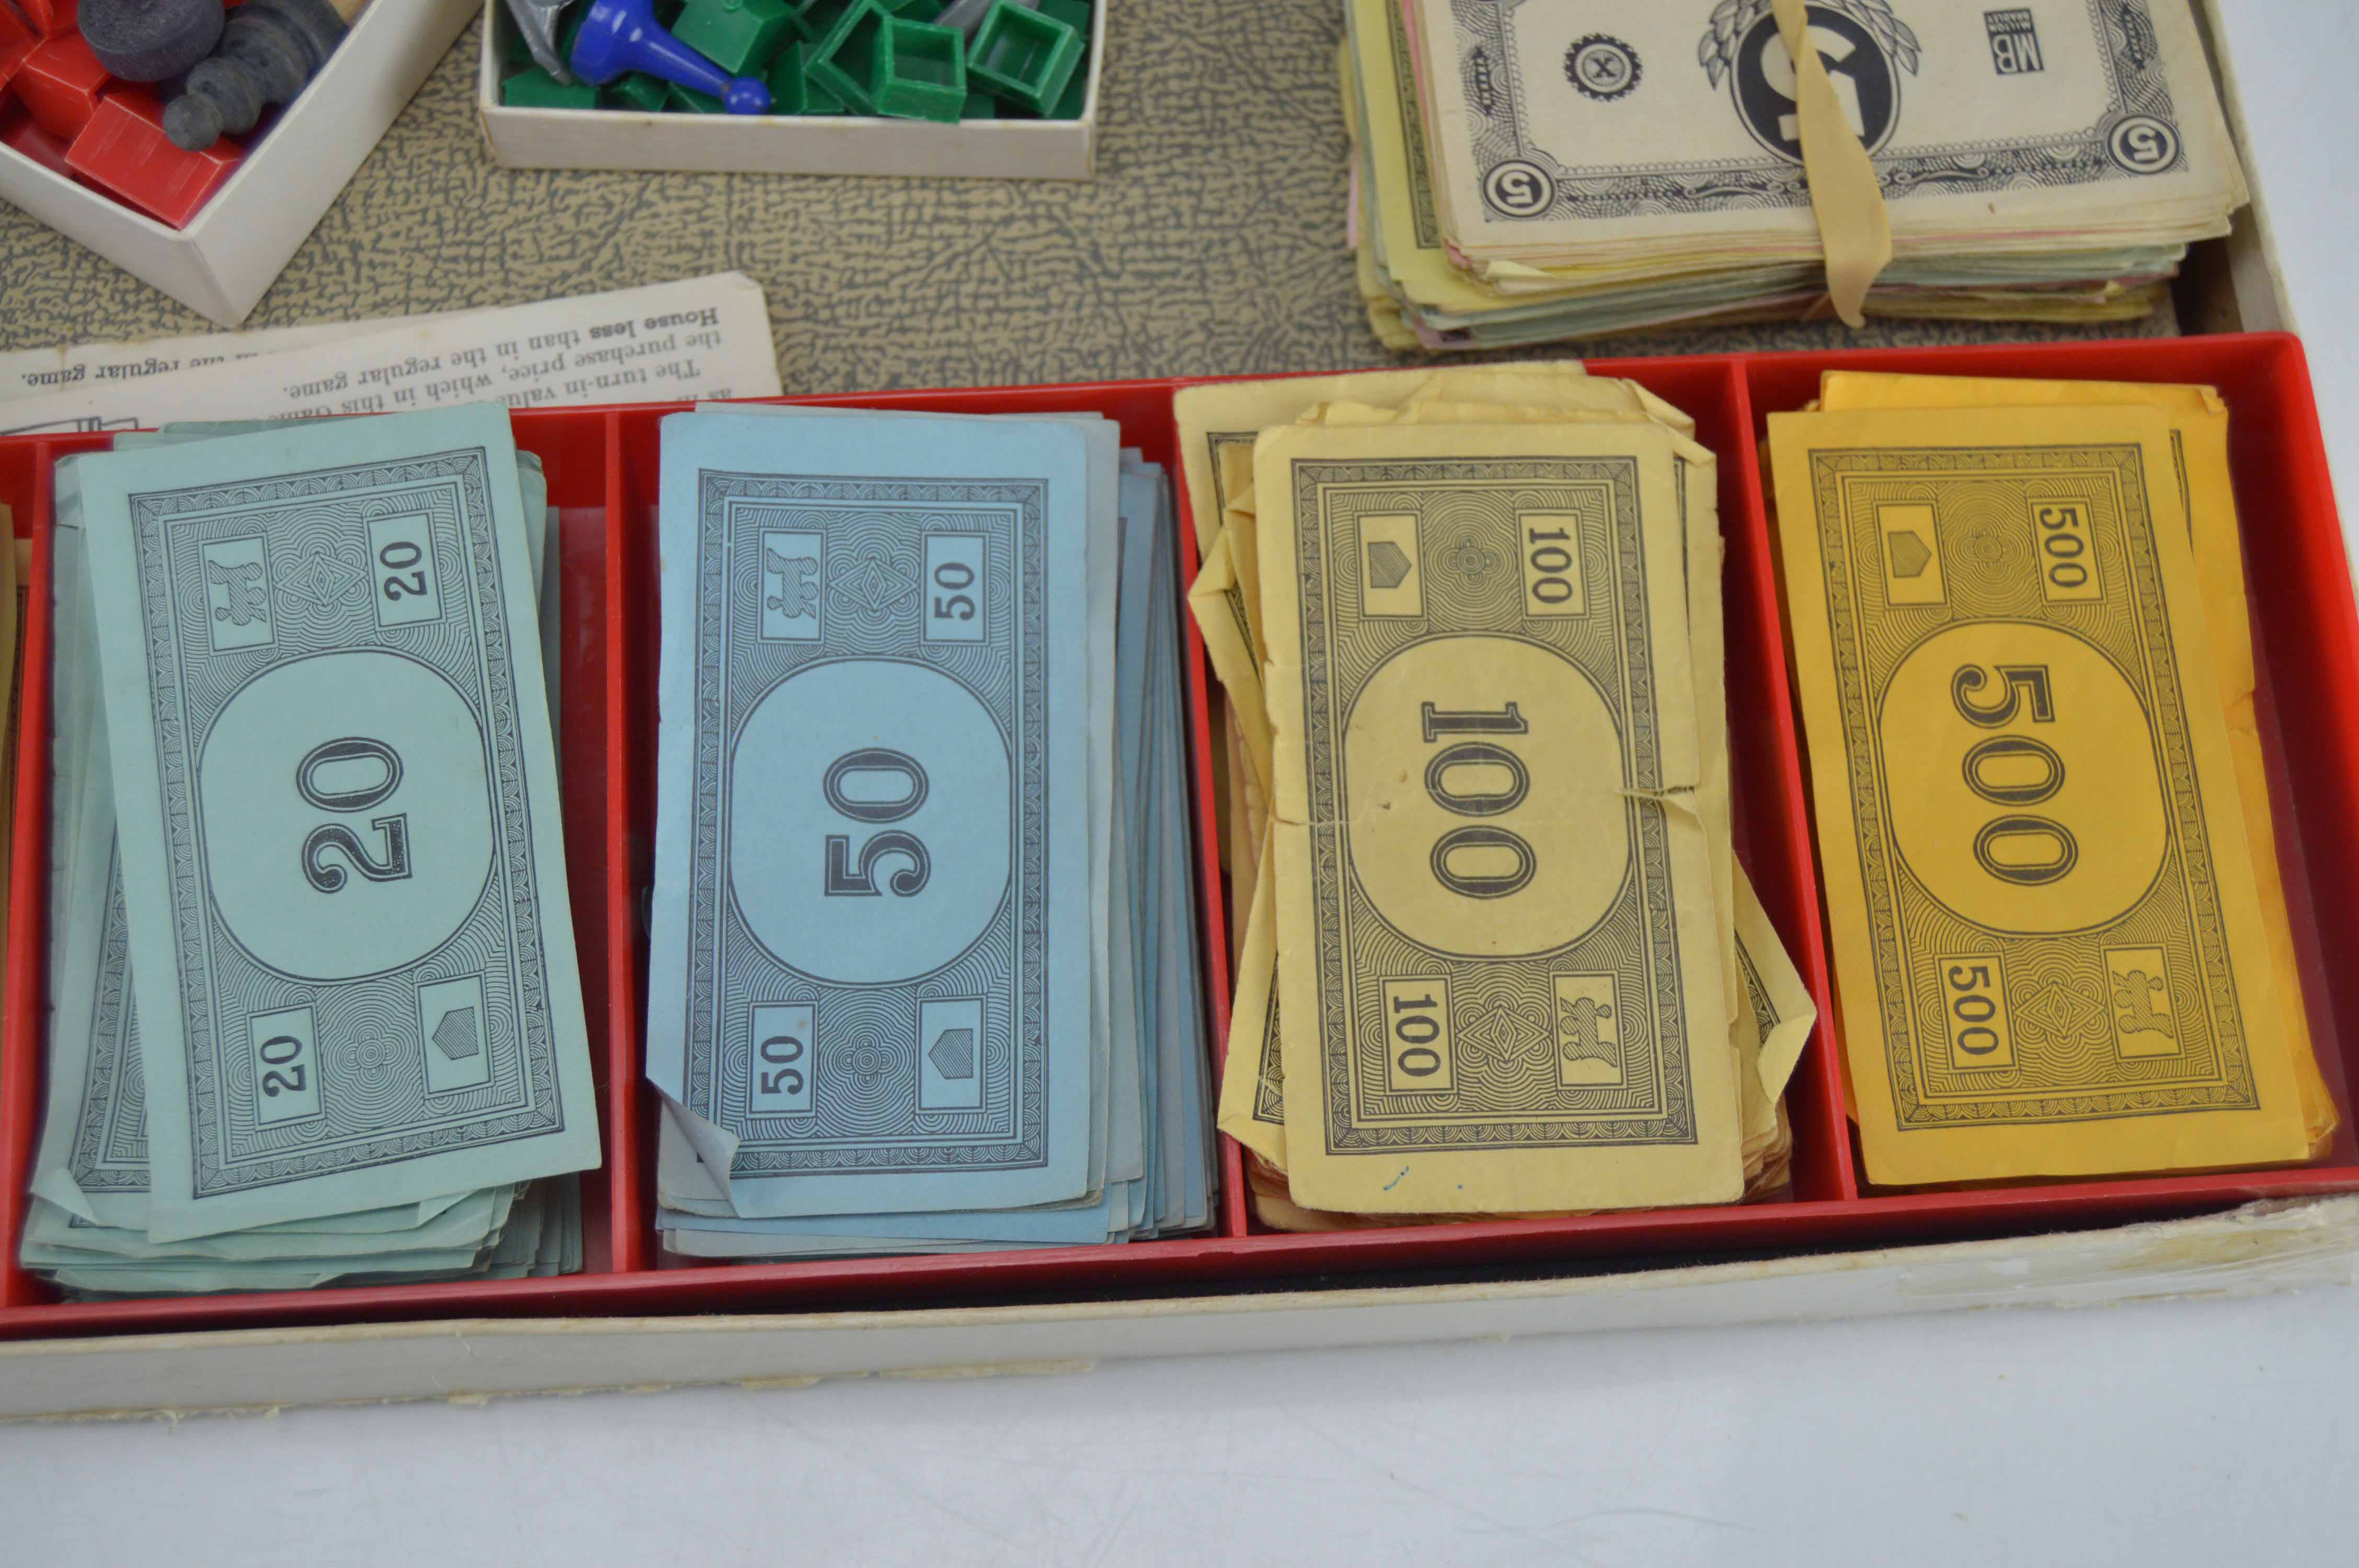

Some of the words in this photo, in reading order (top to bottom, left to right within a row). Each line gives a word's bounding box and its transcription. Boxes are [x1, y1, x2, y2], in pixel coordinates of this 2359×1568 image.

[1592, 57, 1616, 79] X
[1992, 32, 2040, 73] MB
[2127, 126, 2161, 163] 5
[1500, 171, 1534, 204] 5
[589, 320, 637, 340] less
[644, 307, 720, 330] House
[495, 341, 519, 360] in
[529, 329, 580, 350] than
[575, 333, 677, 368] purchase
[686, 329, 722, 348] the
[95, 358, 181, 381] regular
[358, 355, 441, 386] regular
[451, 347, 488, 368] the
[501, 352, 566, 383] price,
[656, 358, 701, 381] The
[21, 363, 86, 387] game.
[283, 371, 348, 399] game.
[426, 371, 493, 401] which
[564, 368, 648, 399] turn-in
[341, 394, 385, 415] this
[393, 386, 416, 407] in
[2039, 506, 2088, 588] 500
[380, 541, 428, 602] 20
[1528, 526, 1574, 604] 100
[934, 561, 976, 621] 50
[1950, 664, 2079, 886] 500
[295, 736, 412, 893] 20
[1422, 701, 1537, 900] 100
[823, 747, 931, 897] 50
[1948, 964, 1999, 1056] 500
[1393, 993, 1441, 1077] 100
[260, 1035, 306, 1098] 20
[760, 1034, 804, 1096] 50
